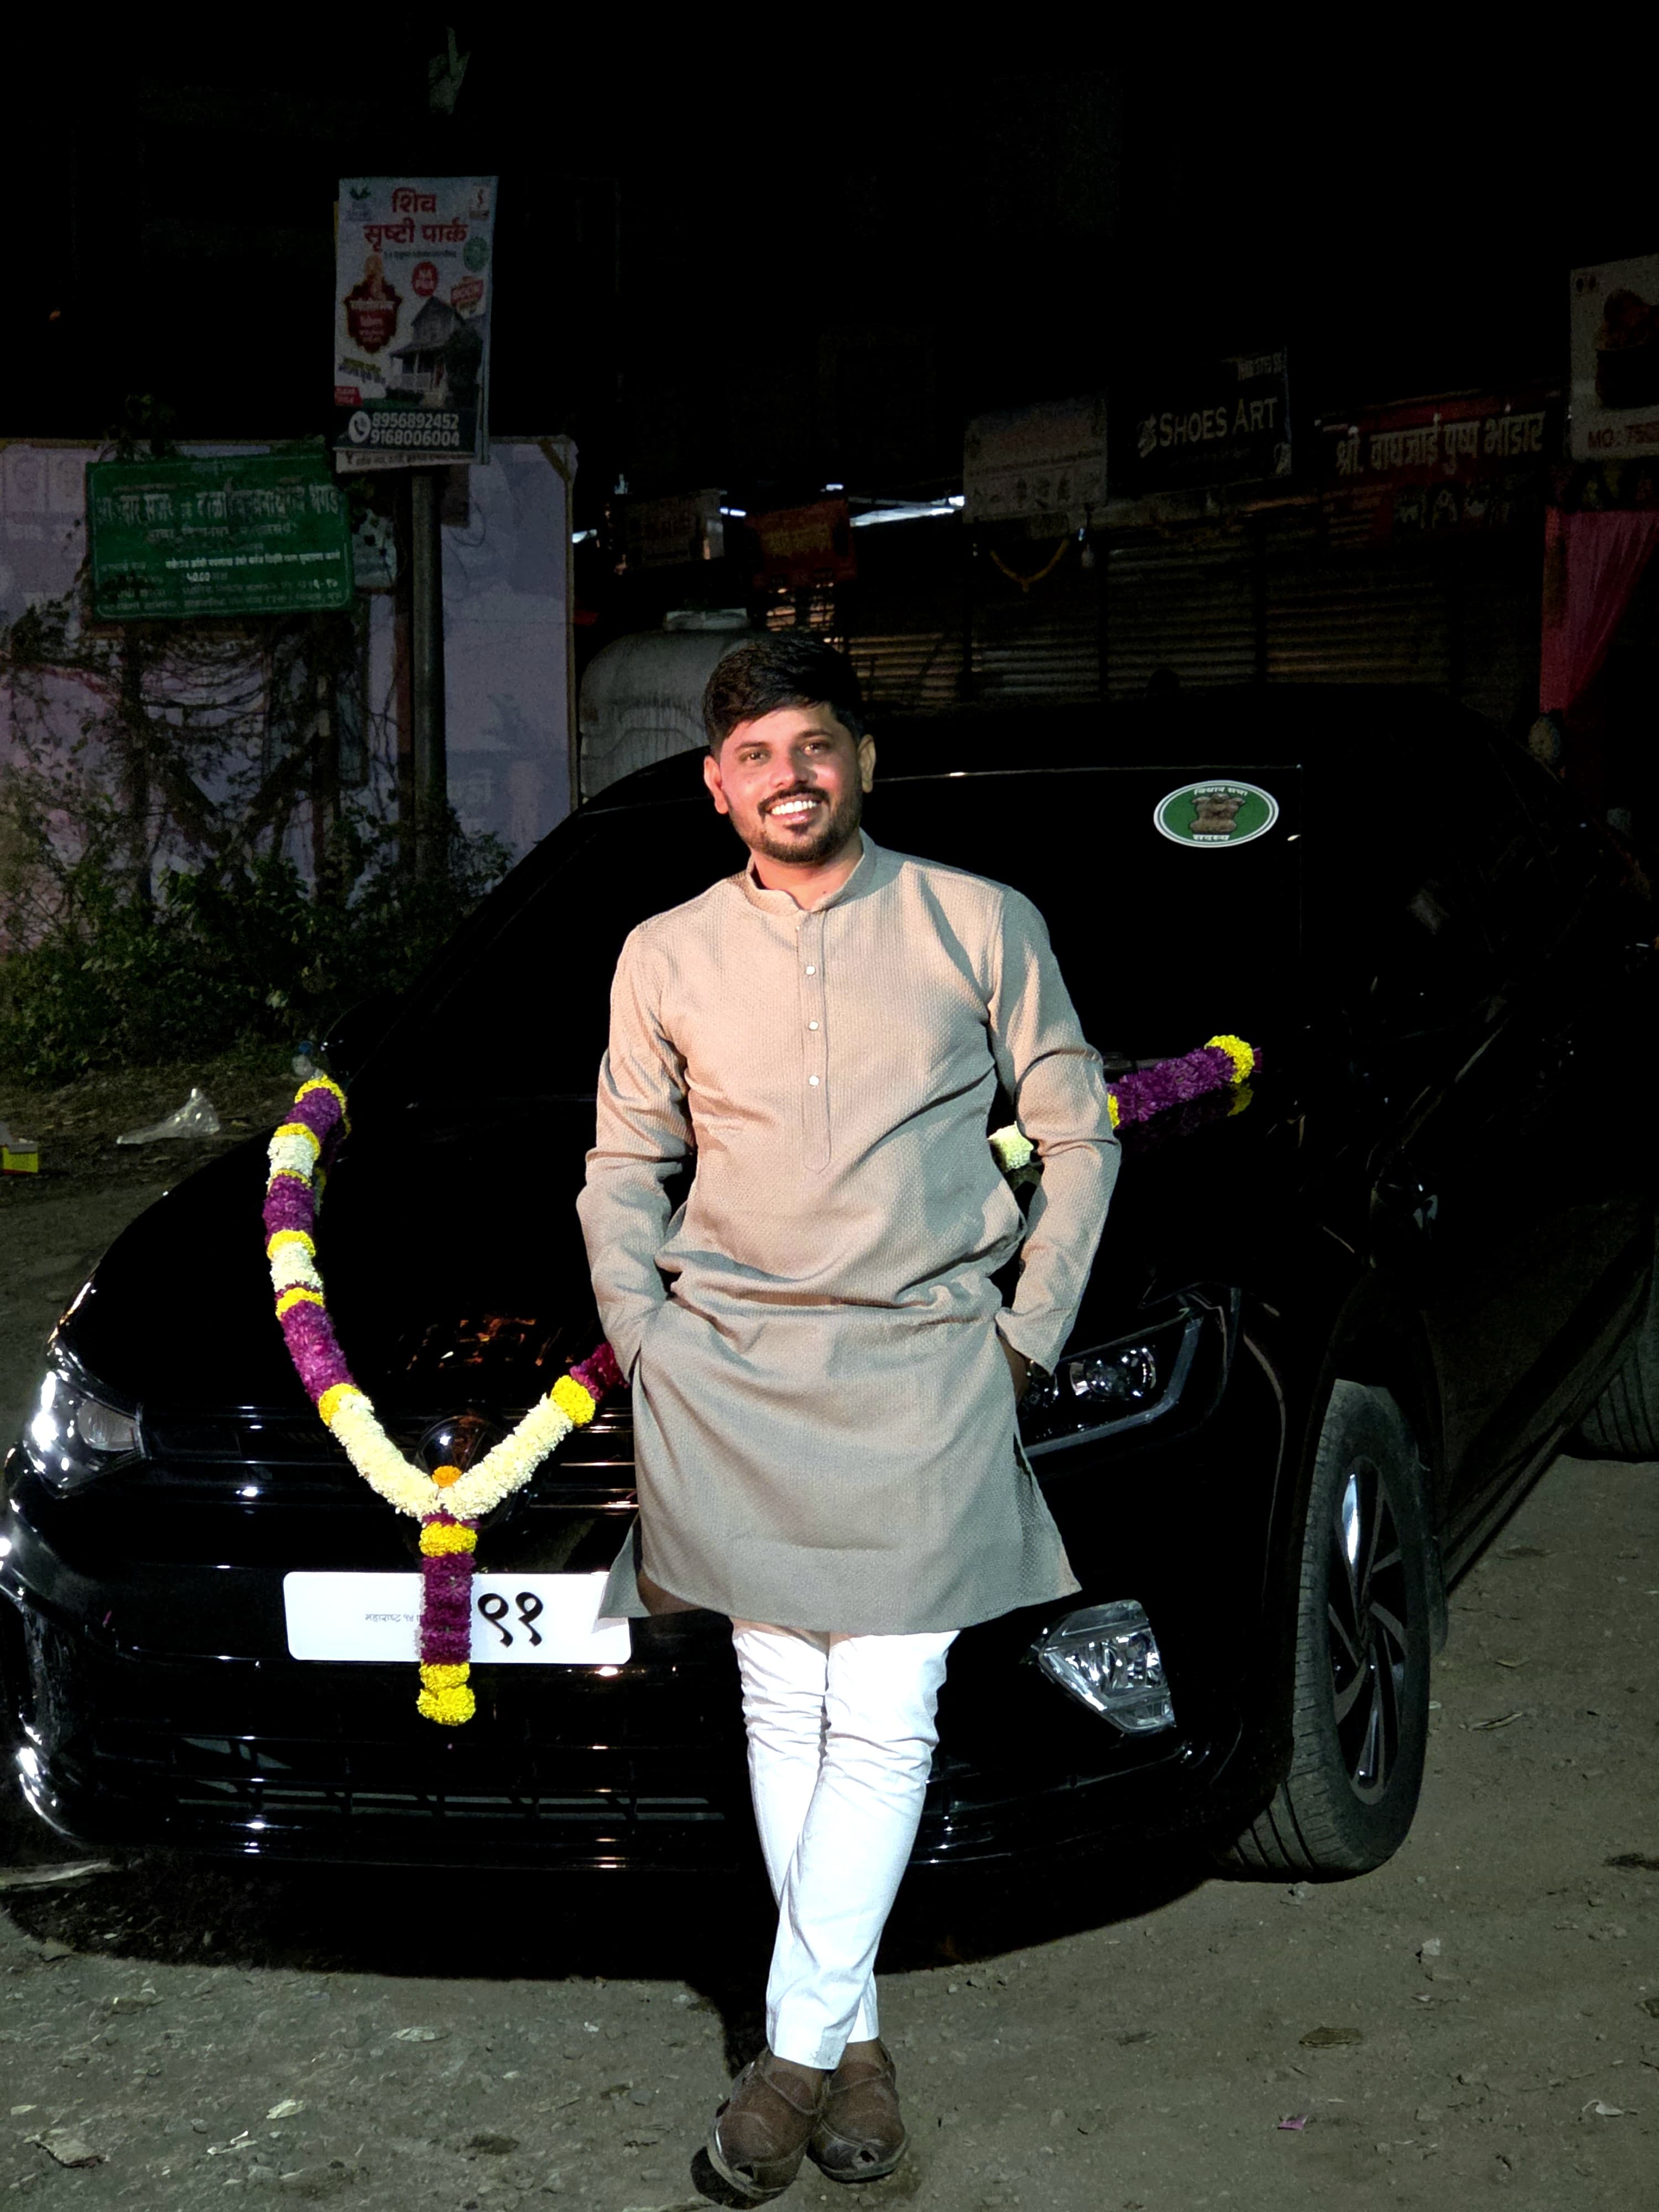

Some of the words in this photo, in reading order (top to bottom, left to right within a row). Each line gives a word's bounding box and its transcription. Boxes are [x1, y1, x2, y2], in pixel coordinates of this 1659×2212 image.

[392, 187, 437, 213] शिव
[363, 217, 415, 252] सृष्टी
[421, 217, 468, 242] पार्क
[371, 412, 460, 430] 8956892452
[1159, 406, 1228, 447] SHOES
[1232, 397, 1279, 436] ART
[371, 429, 460, 446] 9168006004
[1194, 786, 1225, 795] विधान
